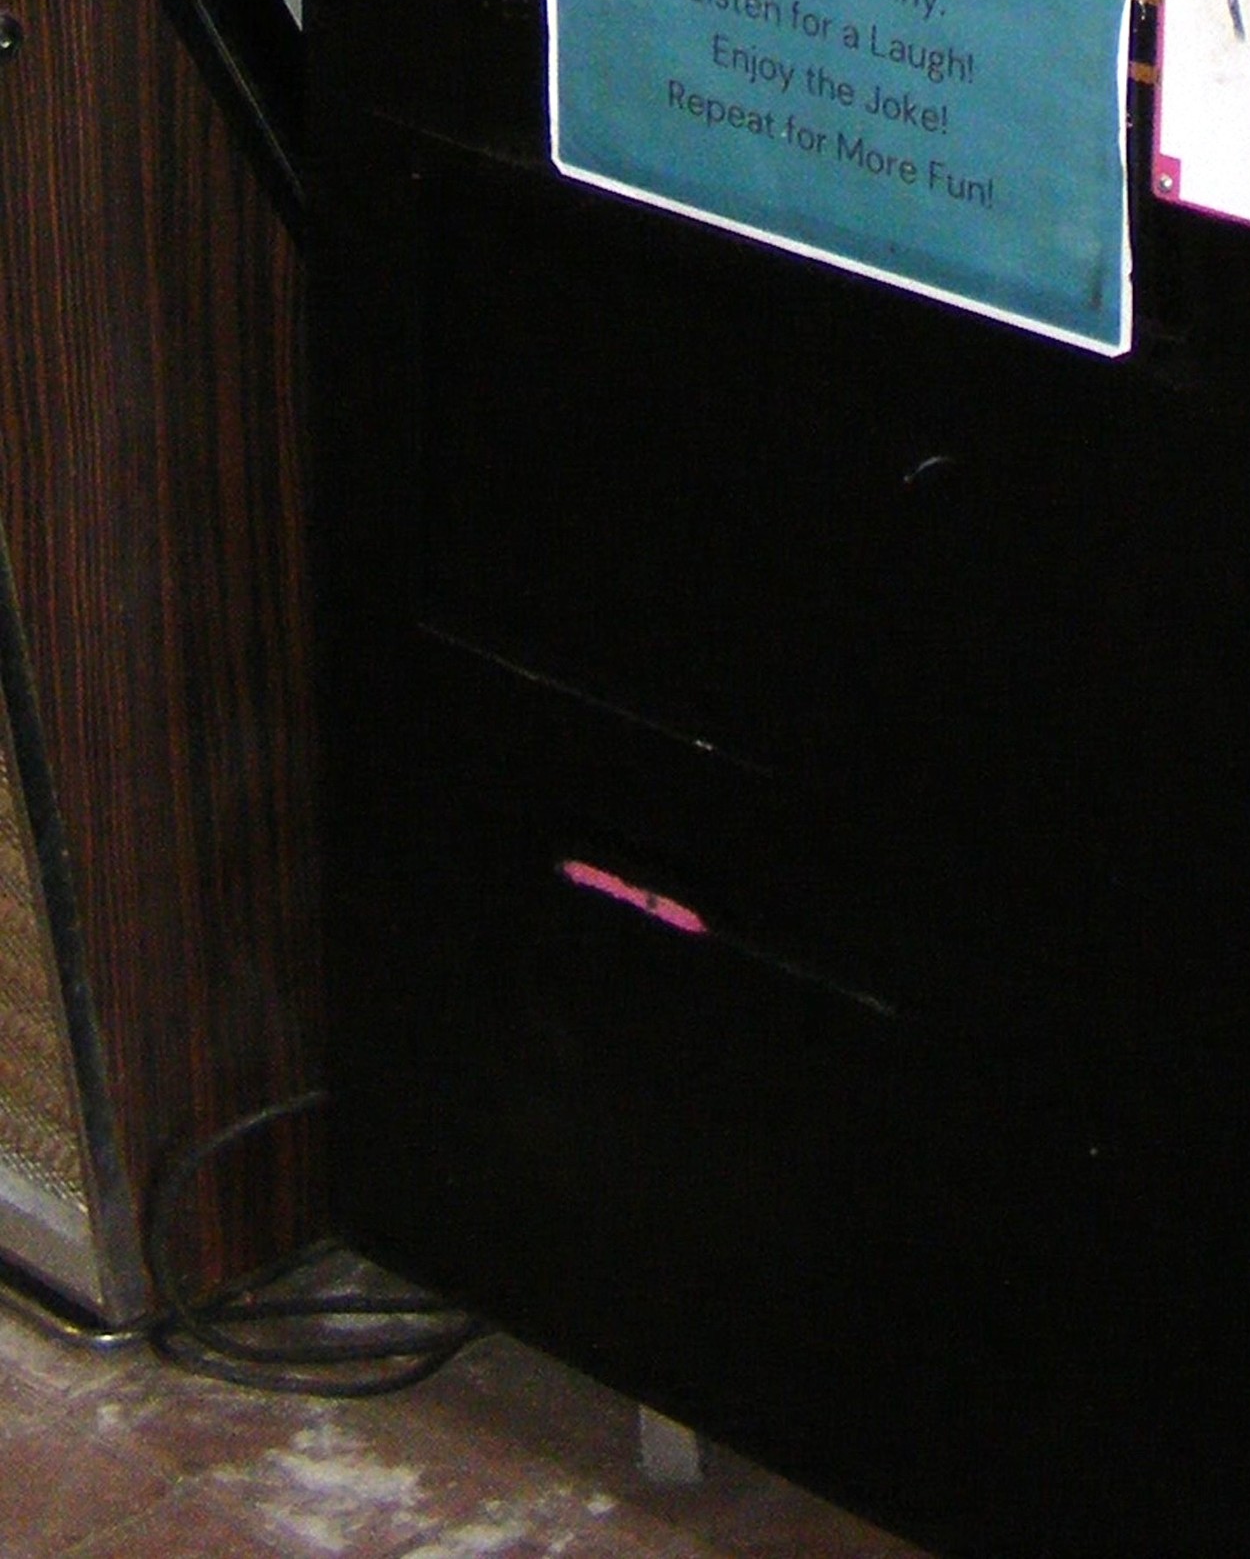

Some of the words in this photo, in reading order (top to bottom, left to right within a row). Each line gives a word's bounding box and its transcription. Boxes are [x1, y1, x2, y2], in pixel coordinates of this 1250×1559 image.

[711, 35, 795, 94] Enjoy
[806, 67, 855, 108] the
[864, 84, 949, 135] Joke!
[791, 2, 832, 42] for
[843, 21, 861, 50] a
[870, 25, 974, 84] Laugh!
[667, 80, 776, 139] Repeat
[785, 115, 828, 154] for
[836, 136, 918, 185] More
[928, 161, 994, 209] Fun!
